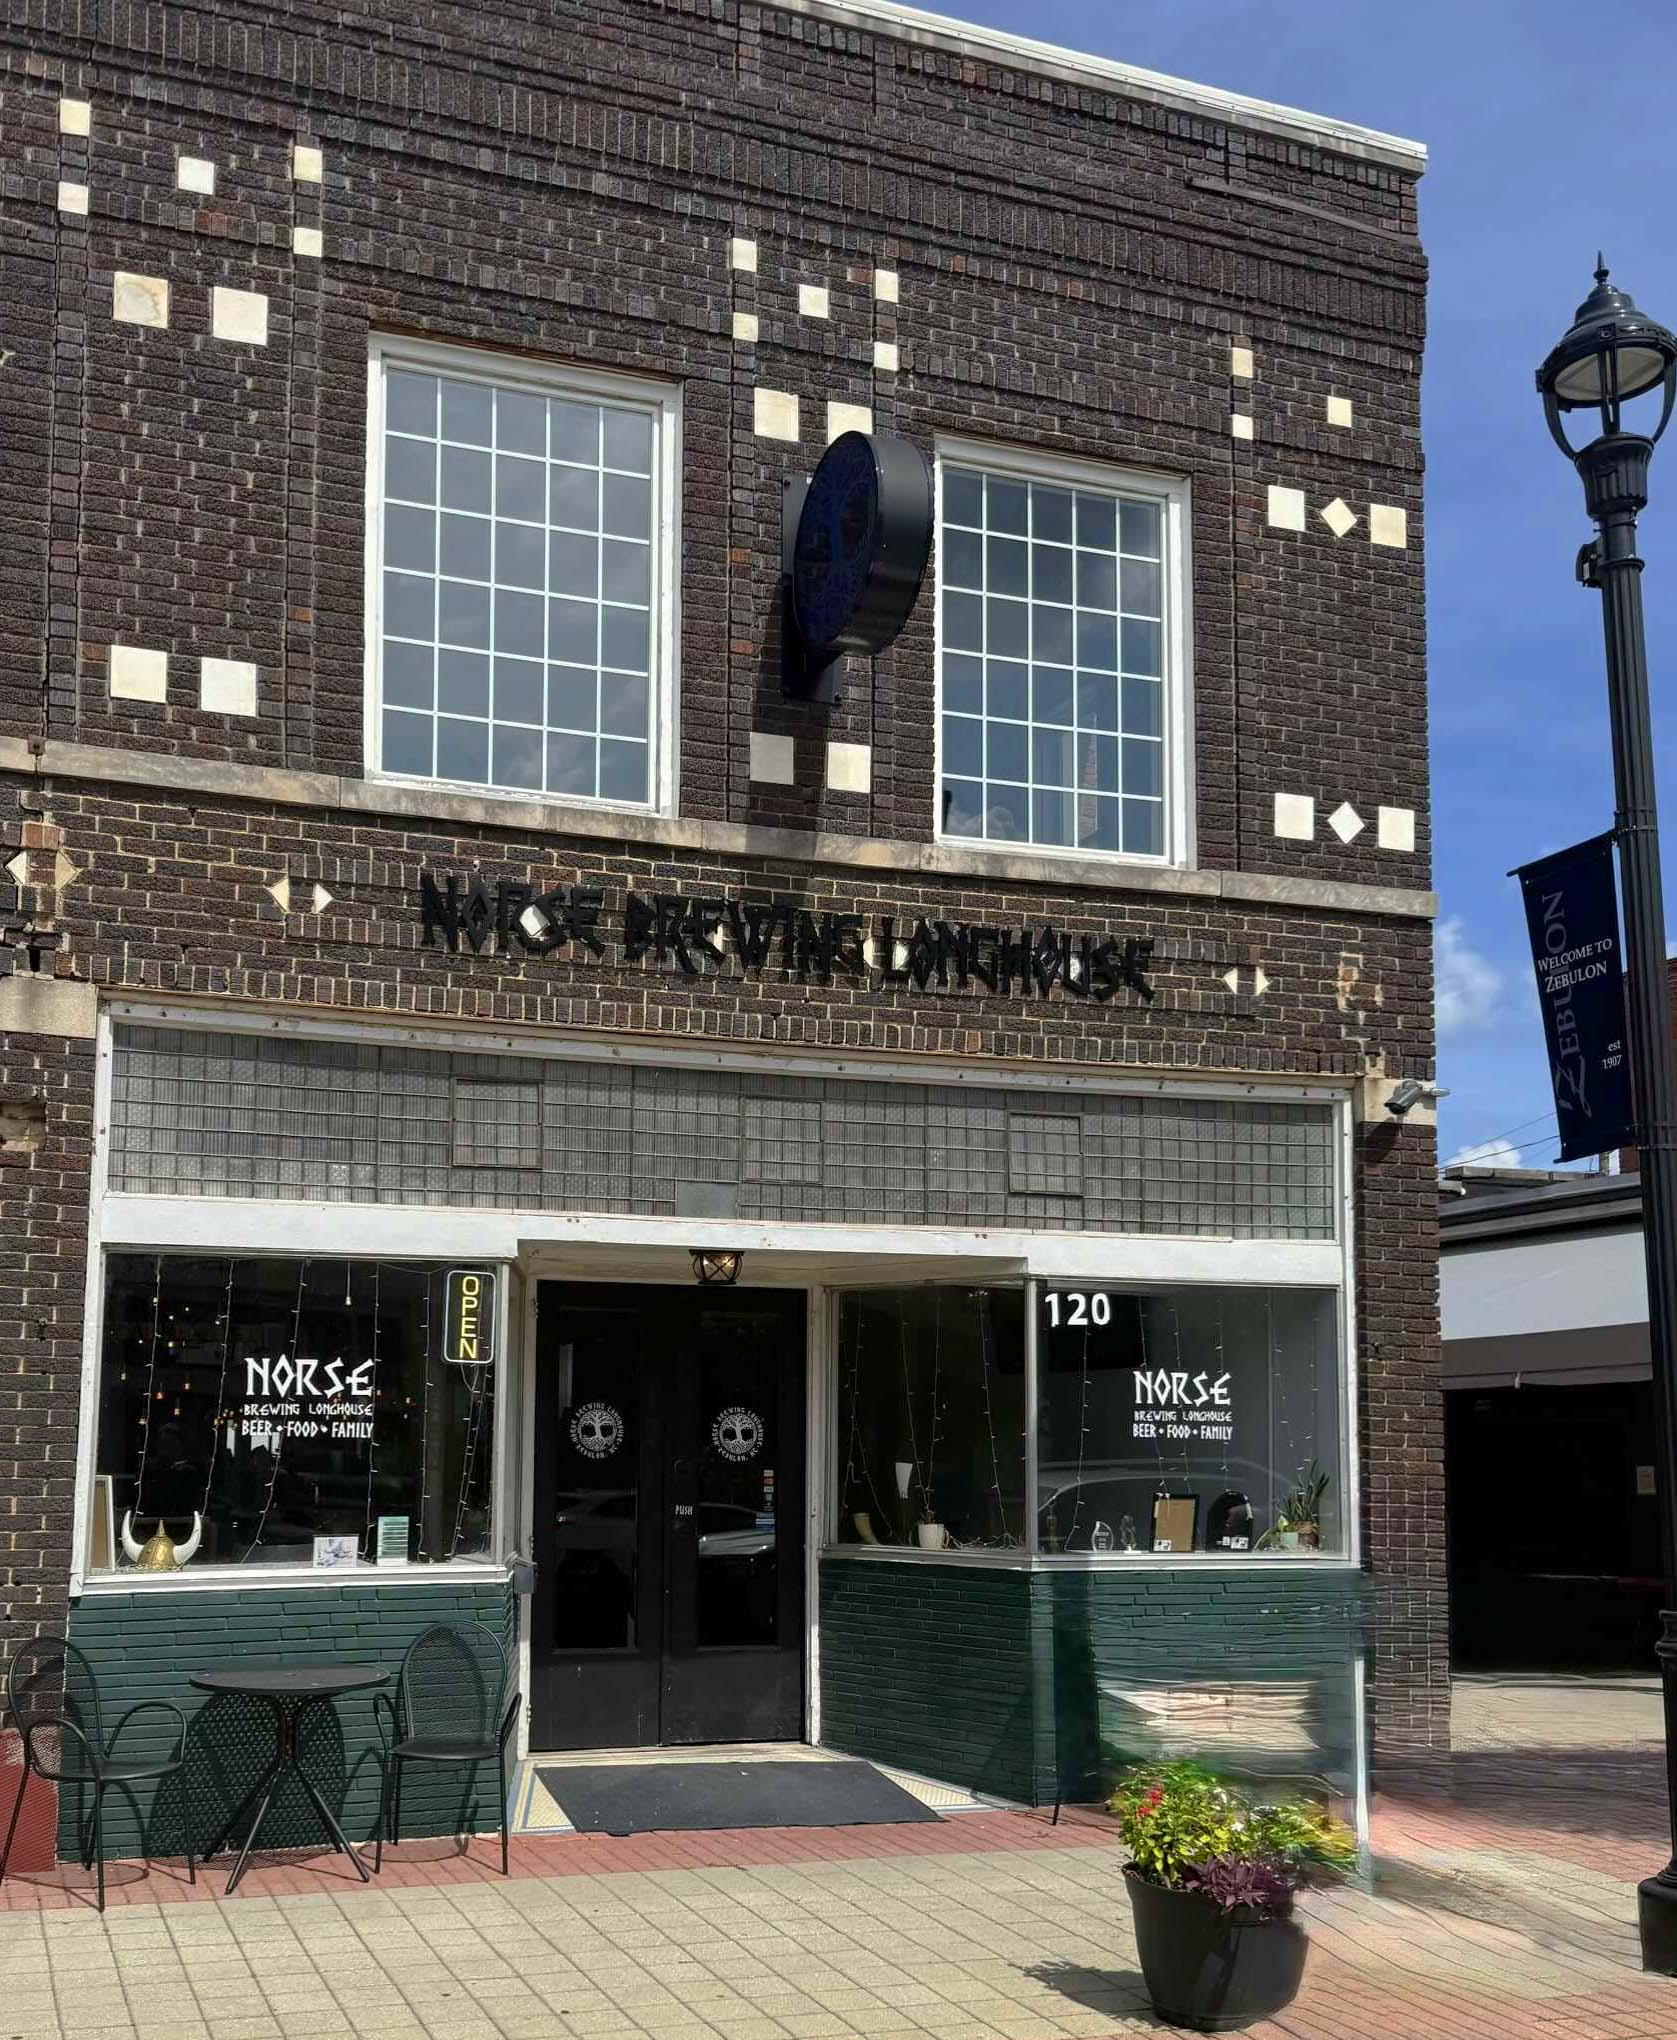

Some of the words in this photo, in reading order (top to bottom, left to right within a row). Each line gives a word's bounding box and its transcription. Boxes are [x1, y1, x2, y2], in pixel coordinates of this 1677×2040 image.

[421, 872, 605, 958] NORSE
[624, 892, 864, 984] BREWING
[883, 916, 1155, 1002] LONGHOUSE
[1537, 944, 1594, 972] WELCOME
[1595, 938, 1612, 953] TO
[1544, 960, 1607, 993] ZEBULON
[1602, 1054, 1622, 1069] 1907
[459, 1276, 480, 1359] OPEN
[1045, 1293, 1111, 1327] 120
[244, 1353, 375, 1398] NORSE
[1132, 1368, 1232, 1407] NORSE
[244, 1403, 300, 1416] BREWING
[309, 1402, 373, 1416] LONGHOUSE
[1134, 1411, 1176, 1422] BREWING
[1183, 1410, 1233, 1422] LONGHOUSE
[241, 1420, 272, 1436] BEER
[286, 1421, 319, 1437] FOOD
[331, 1422, 375, 1438] FAMILY
[1132, 1423, 1157, 1438] BEER
[1167, 1424, 1191, 1439] FOOD
[1200, 1425, 1233, 1440] FAMILY
[675, 1504, 693, 1517] PUSH
